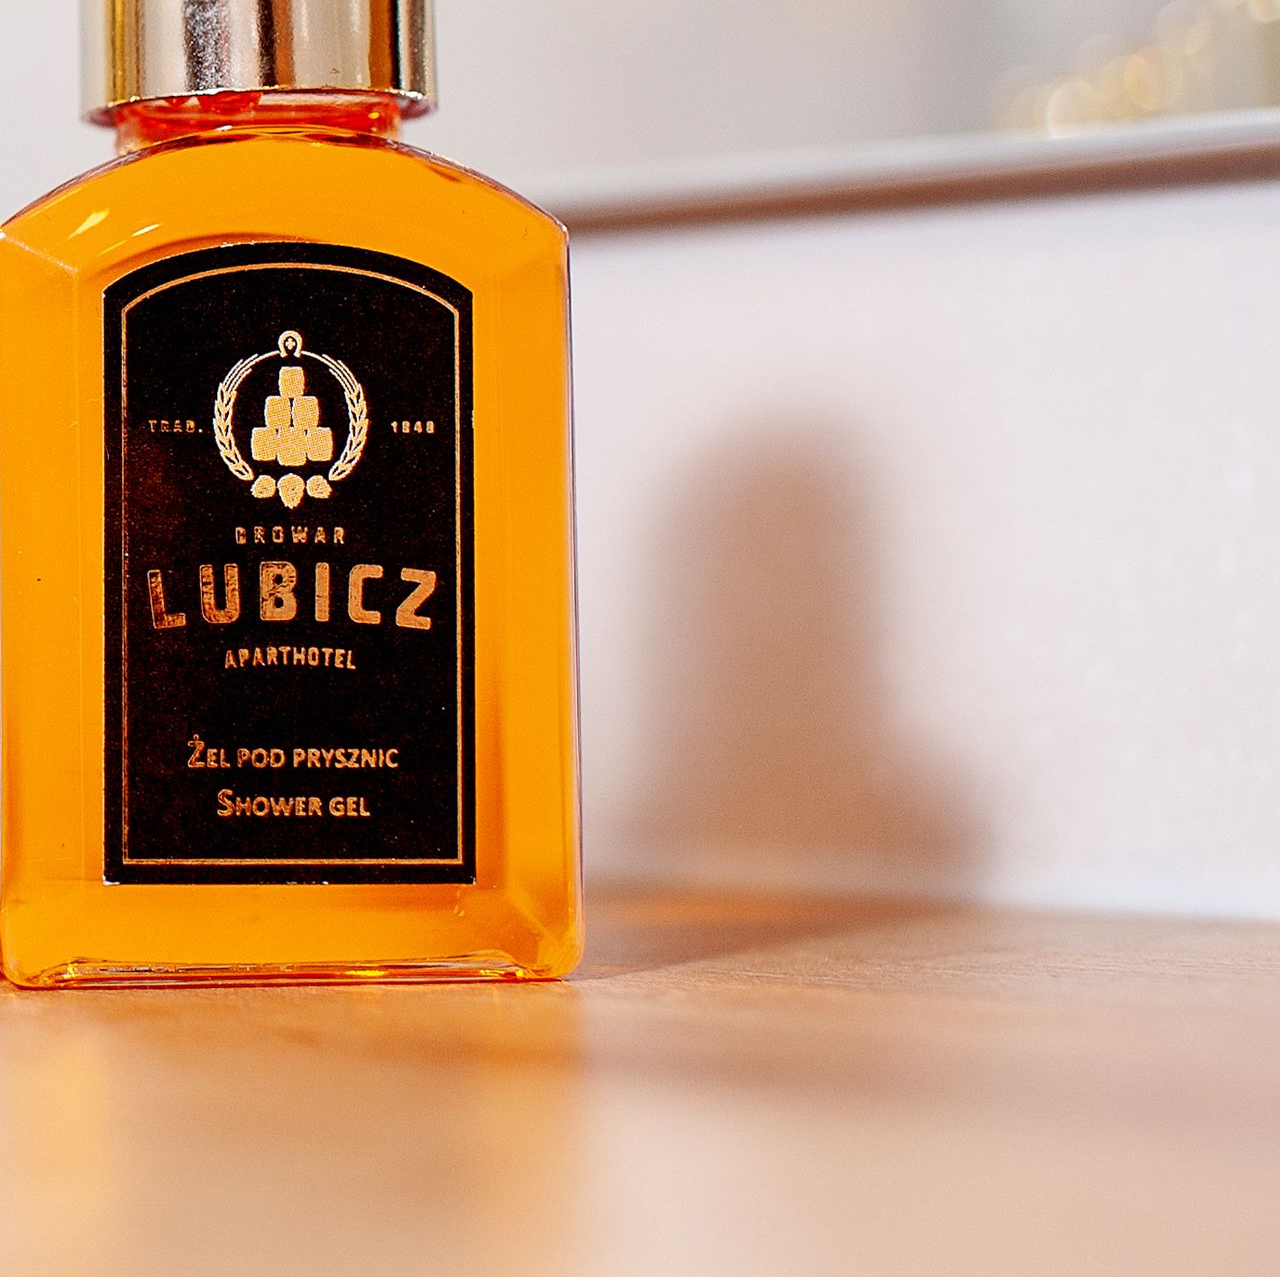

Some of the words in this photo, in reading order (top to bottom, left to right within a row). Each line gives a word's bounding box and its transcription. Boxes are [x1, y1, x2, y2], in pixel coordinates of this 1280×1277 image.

[235, 526, 346, 544] BROWAR
[147, 561, 437, 630] LUBICZ
[224, 646, 356, 670] APARTHOTEL
[237, 748, 286, 768] POD
[293, 748, 399, 768] PRYSZNIC
[217, 788, 322, 817] SHOWER
[329, 796, 371, 817] GEL
